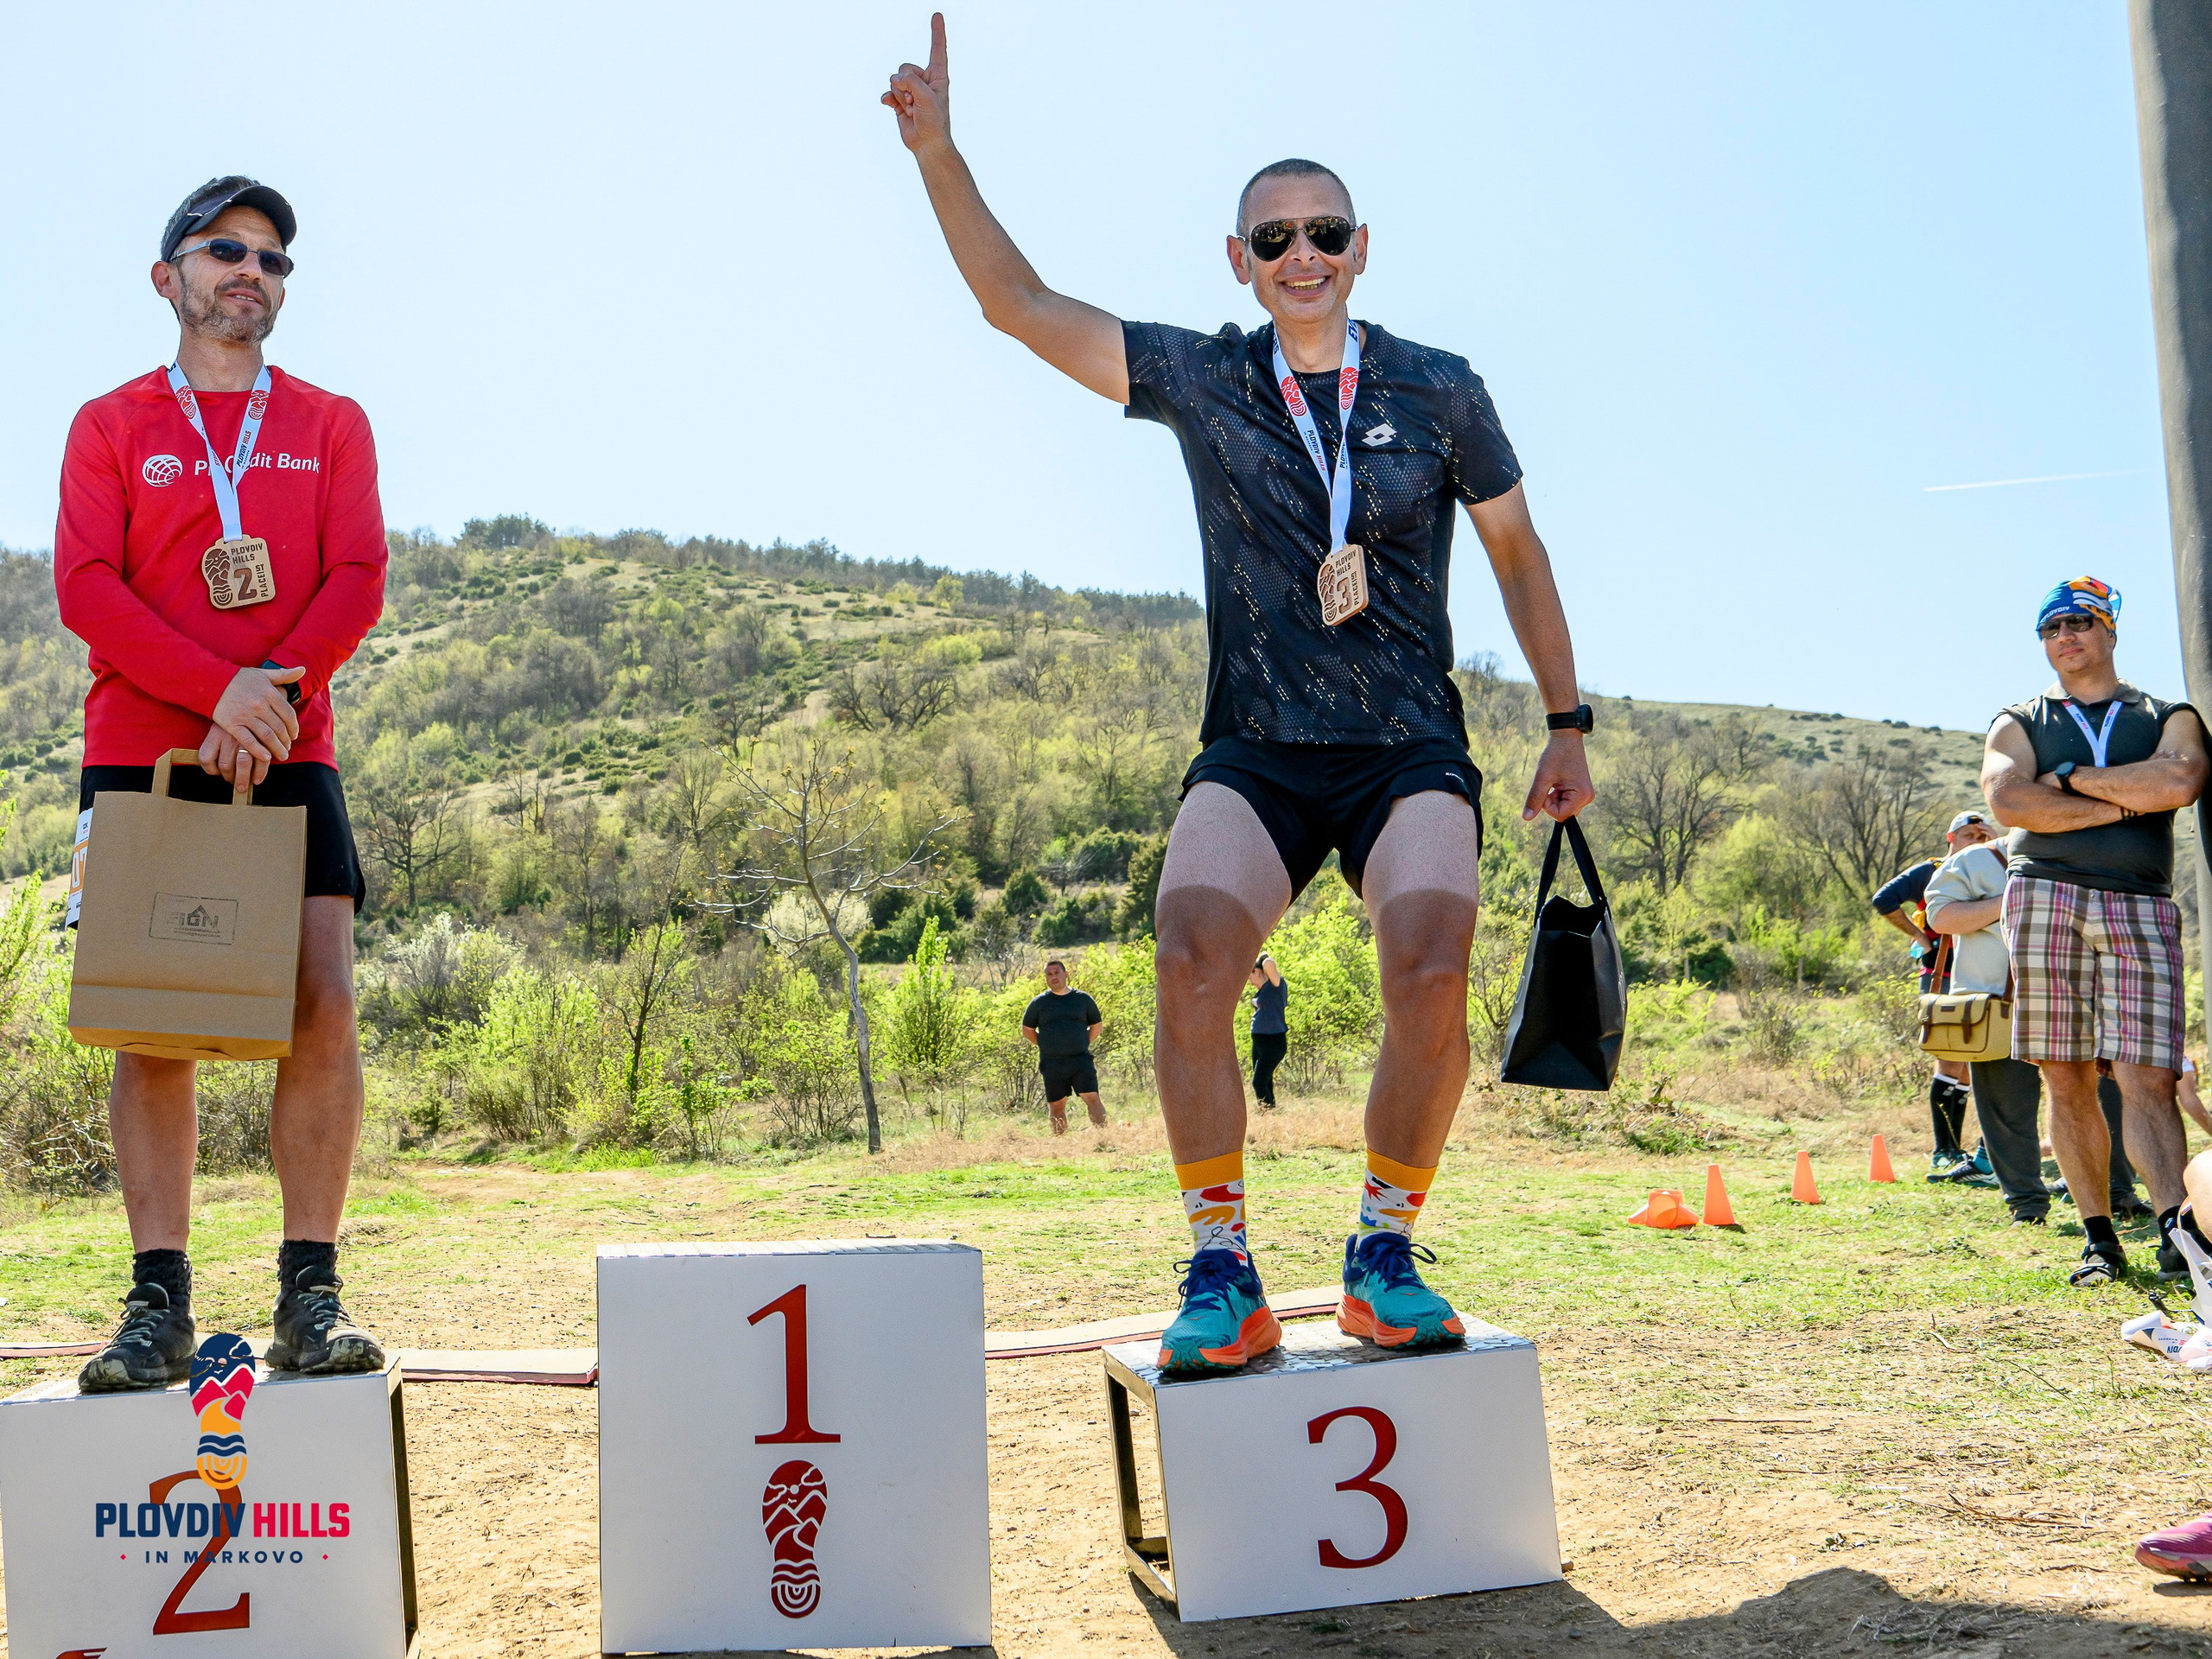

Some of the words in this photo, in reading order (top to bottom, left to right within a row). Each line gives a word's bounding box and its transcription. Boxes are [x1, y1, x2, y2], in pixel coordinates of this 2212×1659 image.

[276, 453, 321, 474] Bank
[231, 543, 264, 556] PLOVDIV
[232, 553, 256, 564] HILLS
[1335, 549, 1357, 569] PLOVDIV
[1336, 562, 1351, 577] HILLS
[233, 567, 258, 601] 2
[1336, 576, 1353, 614] 3
[747, 1284, 842, 1445] 1
[1306, 1406, 1408, 1569] 3
[149, 1469, 250, 1636] 2
